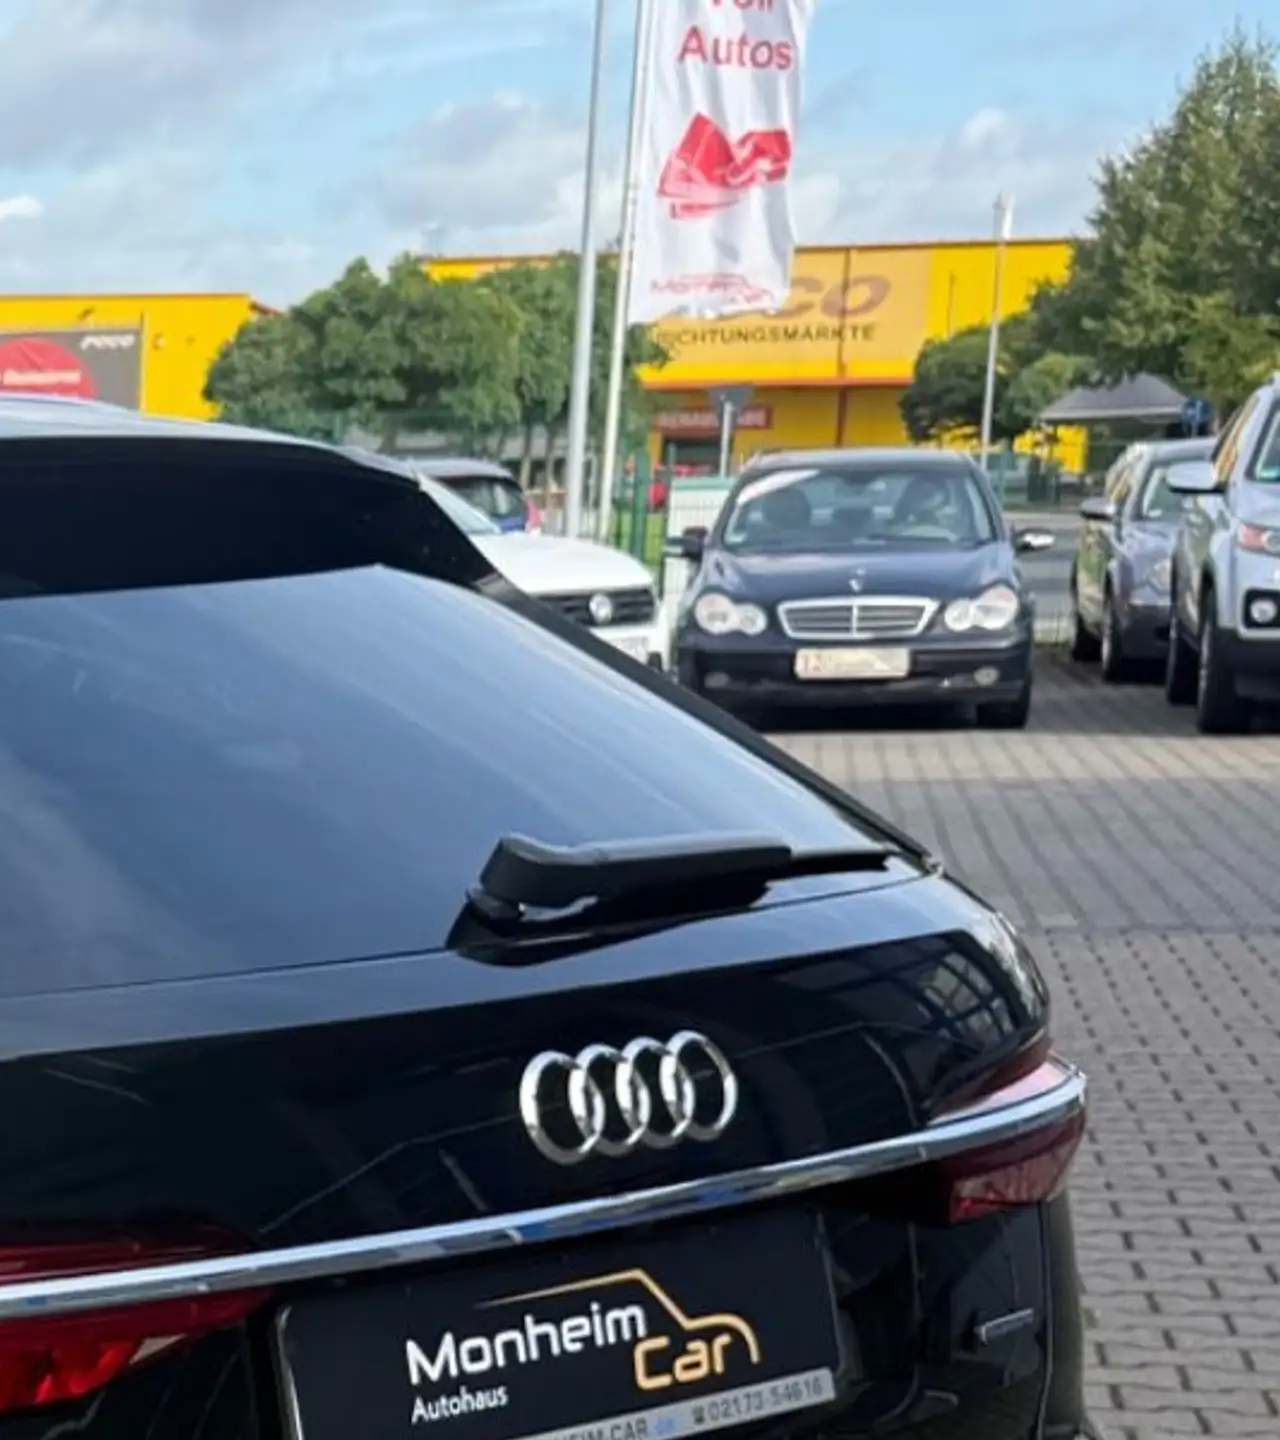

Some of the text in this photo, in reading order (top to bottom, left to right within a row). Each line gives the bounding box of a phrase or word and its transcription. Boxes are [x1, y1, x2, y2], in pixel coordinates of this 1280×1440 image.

[677, 25, 792, 71] Autos
[406, 1303, 732, 1390] Monheim Car
[411, 1384, 509, 1424] Autohaus
